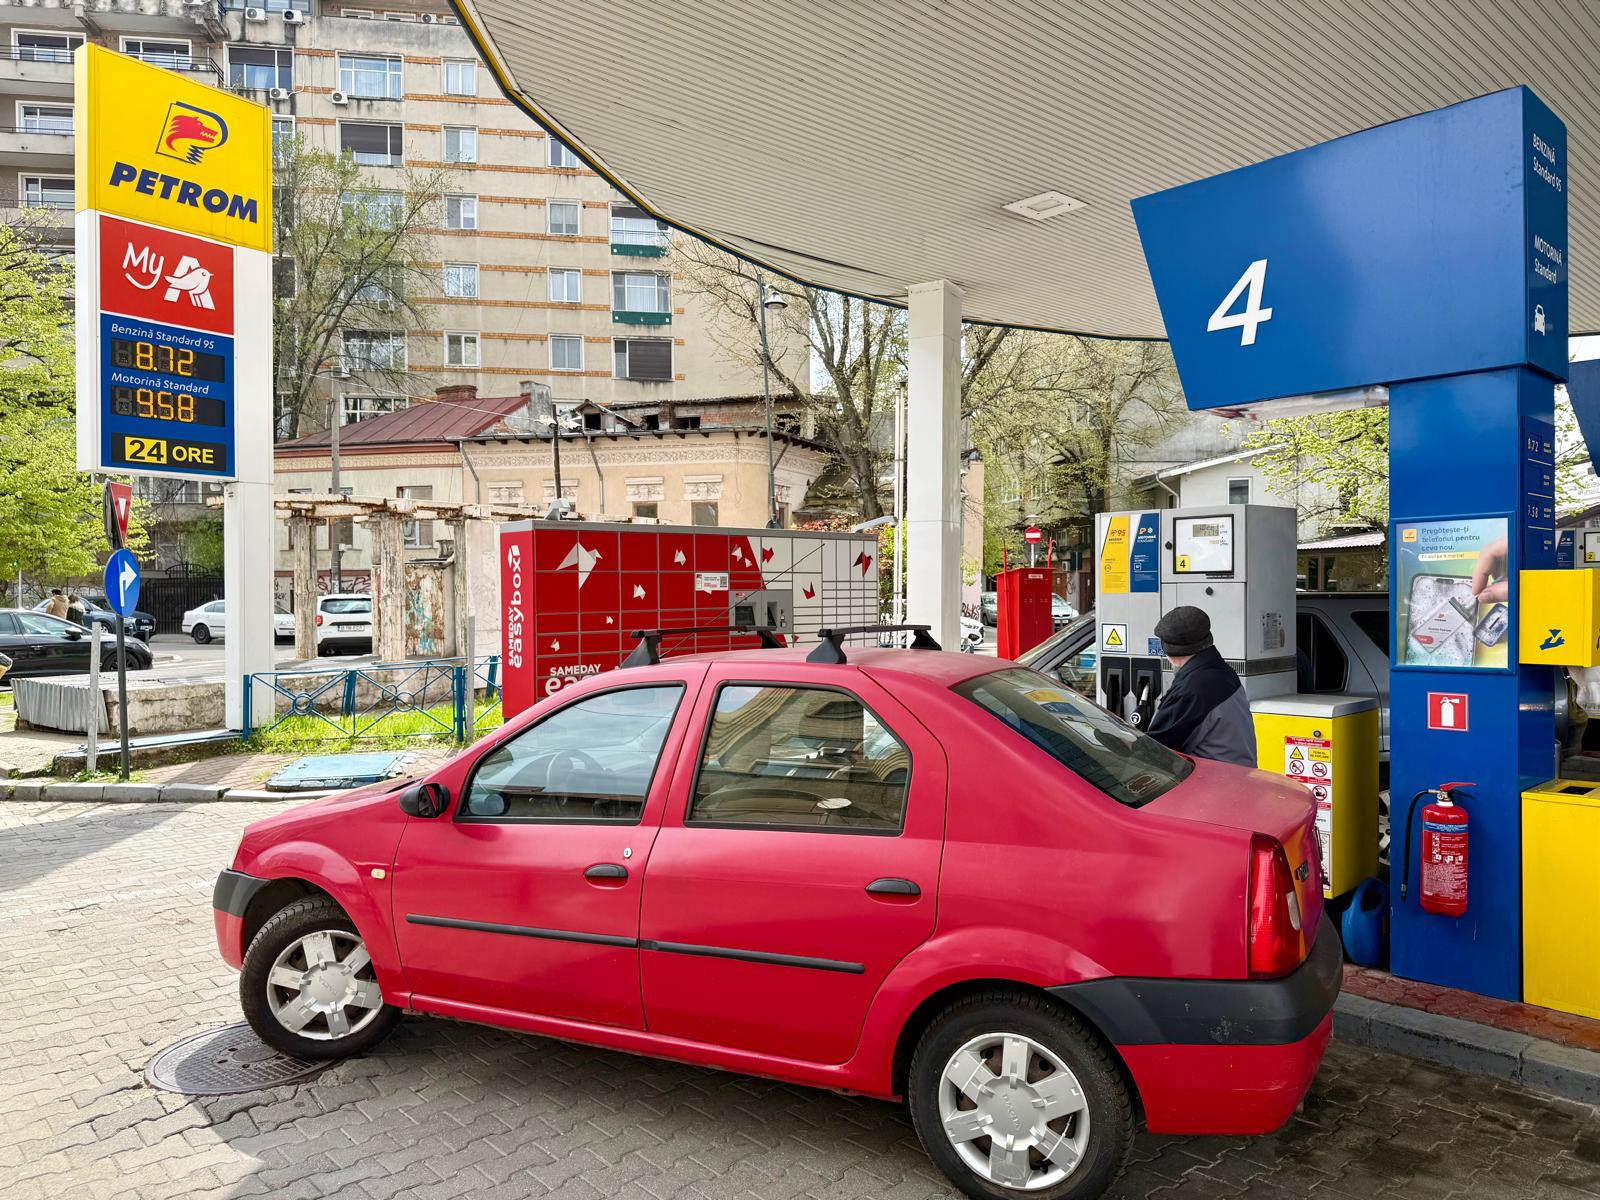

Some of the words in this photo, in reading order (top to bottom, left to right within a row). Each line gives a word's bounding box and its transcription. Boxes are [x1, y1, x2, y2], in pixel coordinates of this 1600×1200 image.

[1533, 156, 1555, 188] Standard
[1556, 176, 1562, 192] 95
[109, 161, 258, 224] PETROM
[122, 241, 165, 290] My
[1534, 234, 1562, 268] MOTORINĂ
[1535, 258, 1556, 284] Standard
[1207, 258, 1273, 347] 4
[111, 323, 154, 339] Benzină
[155, 331, 202, 347] Standard
[203, 339, 216, 350] 95
[136, 341, 194, 377] 8.72
[111, 372, 161, 388] Motorină
[163, 380, 210, 395] Standard
[136, 388, 194, 423] 9.58
[128, 439, 165, 462] 24
[172, 445, 214, 465] ORE
[1455, 534, 1480, 542] pentru
[1179, 559, 1186, 569] 4
[511, 557, 524, 669] easybox
[550, 664, 601, 676] SAMEDAY
